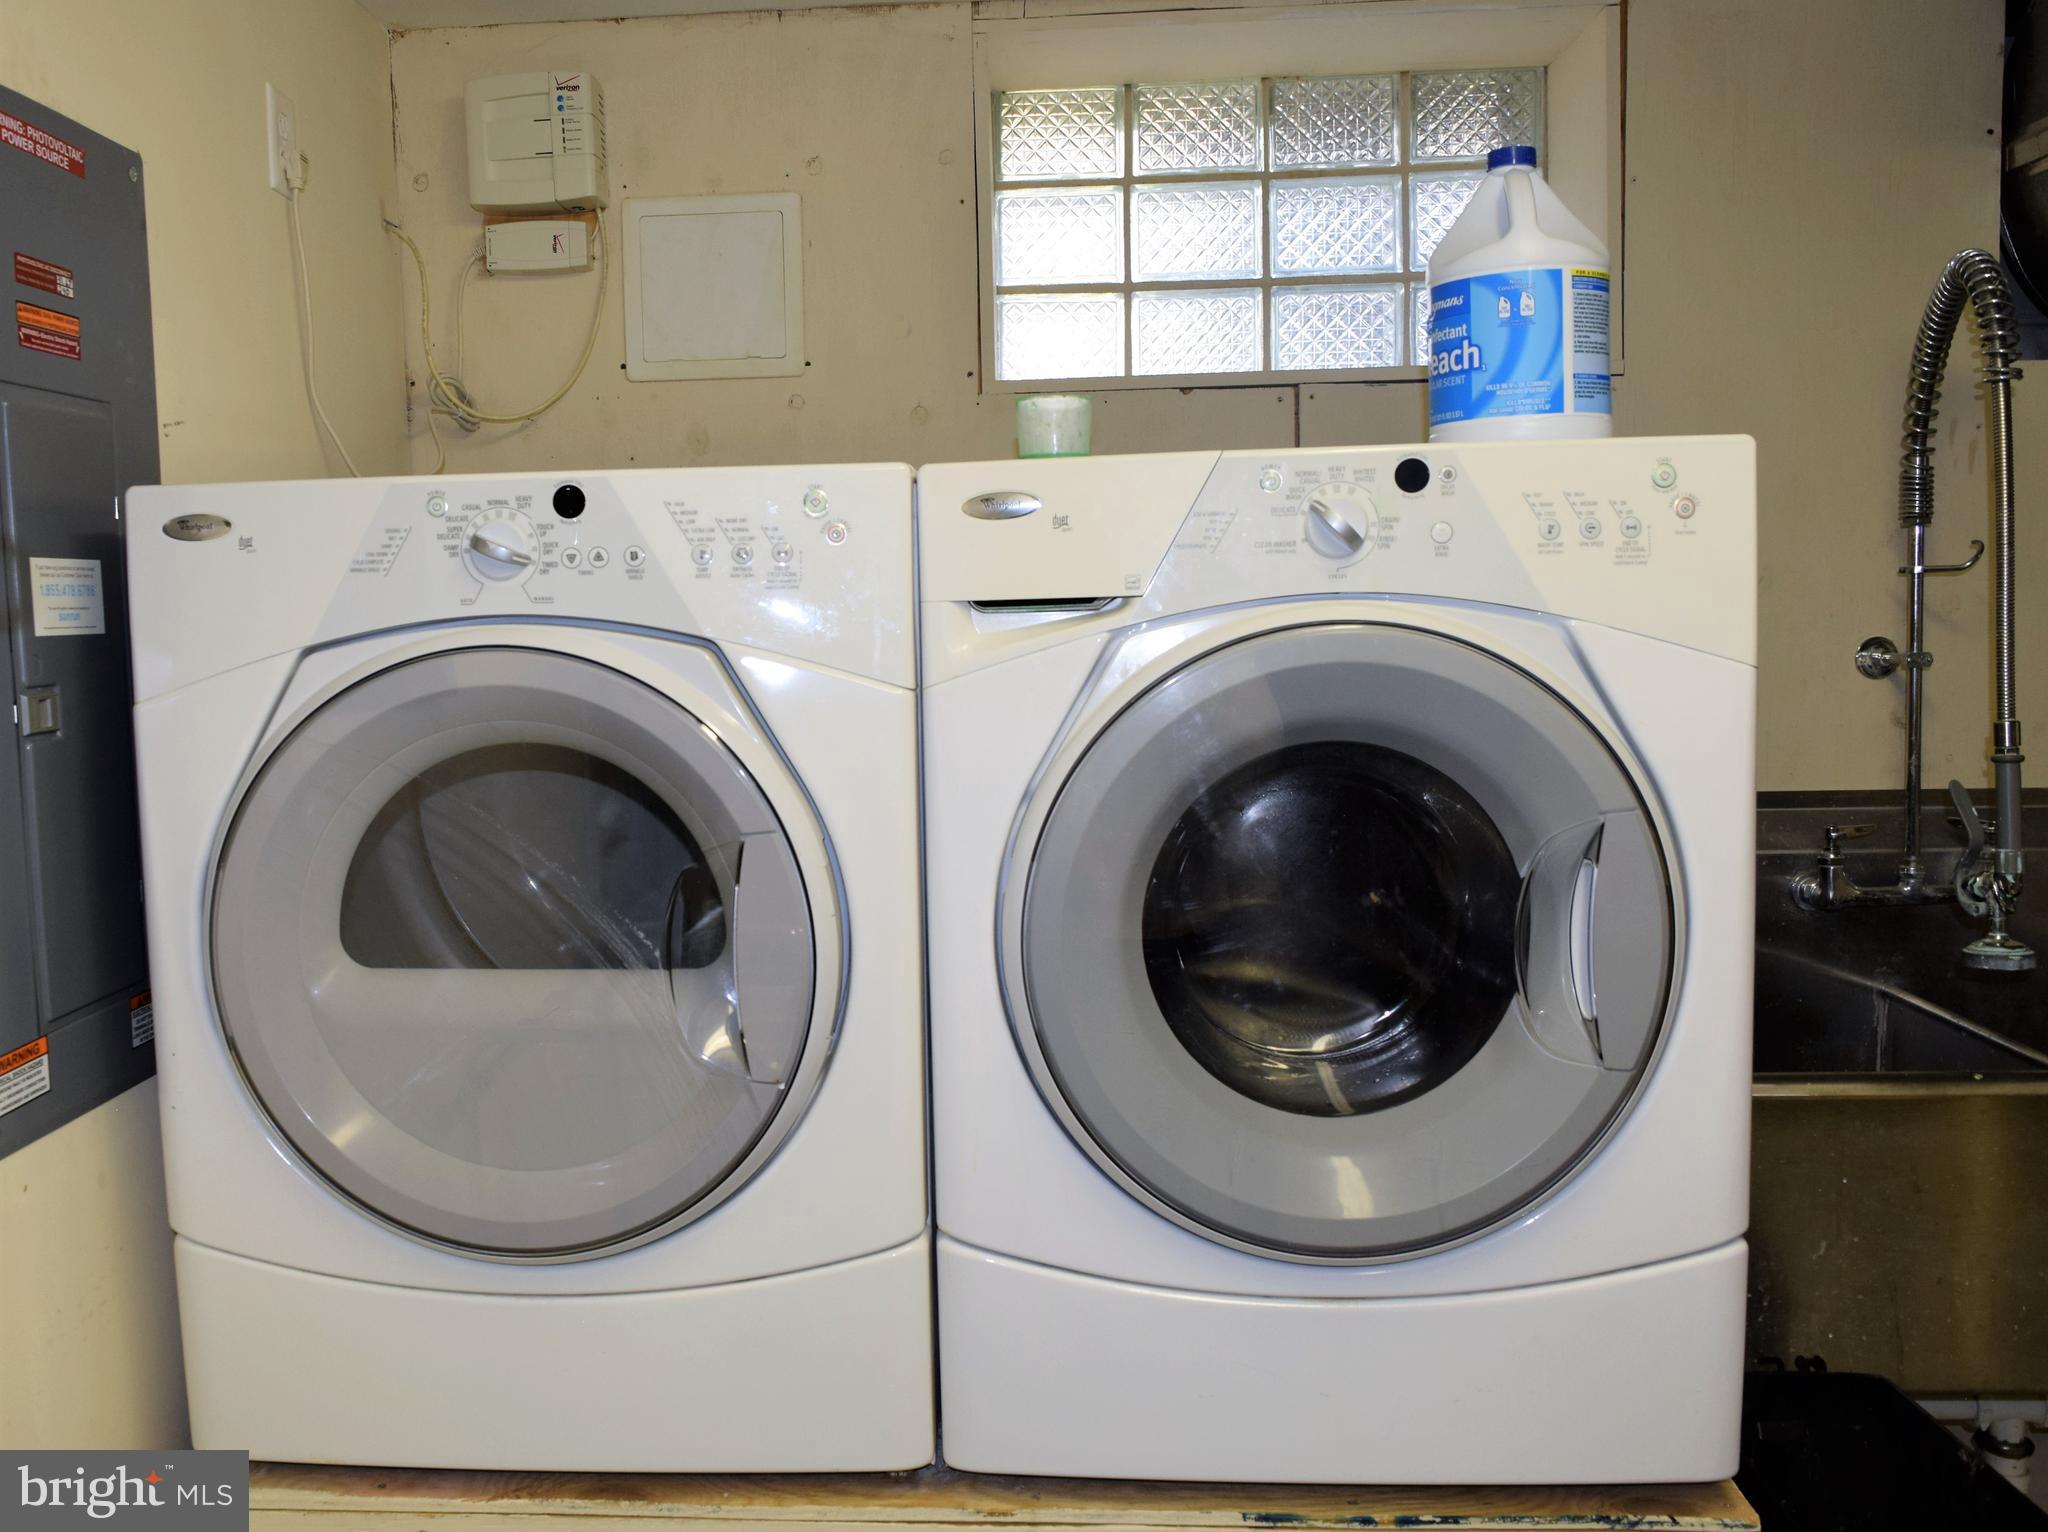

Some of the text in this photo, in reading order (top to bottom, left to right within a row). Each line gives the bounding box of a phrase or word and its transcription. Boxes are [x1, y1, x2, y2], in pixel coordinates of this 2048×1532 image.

[2, 128, 70, 170] POWER SOURCE
[27, 126, 84, 163] PHOTOVOLTAIC
